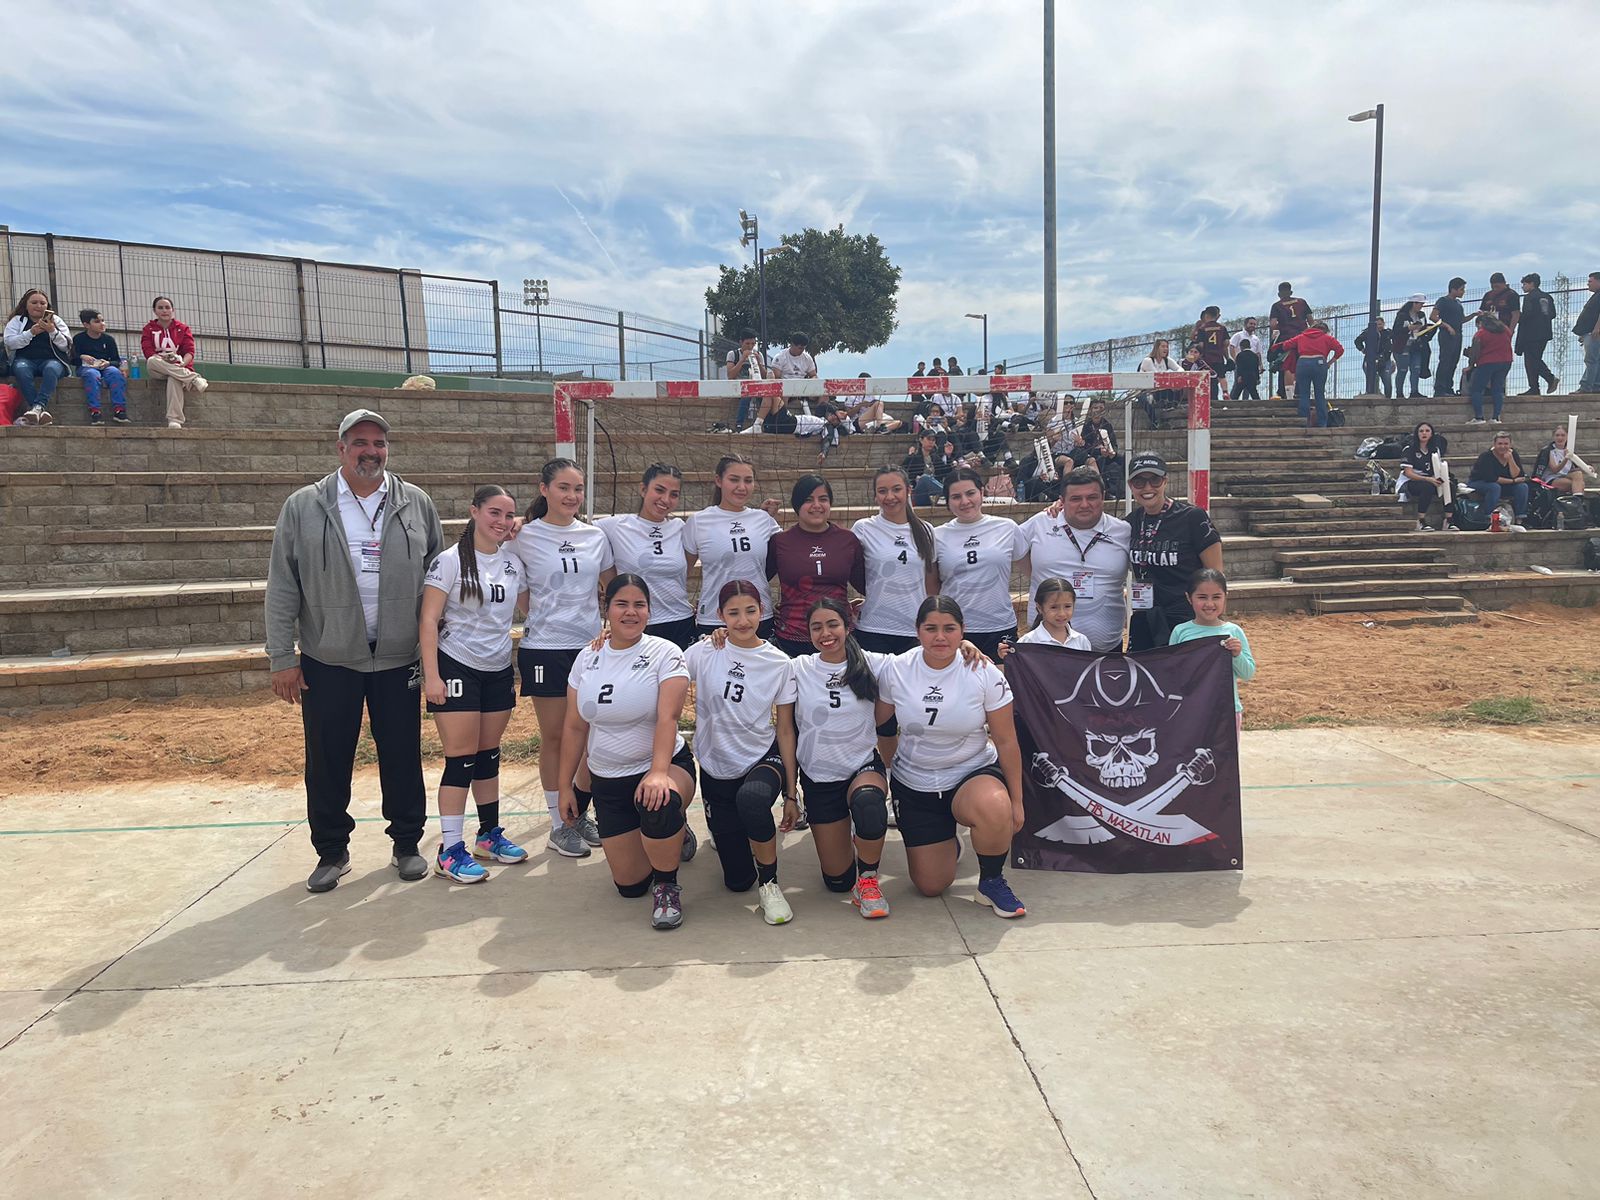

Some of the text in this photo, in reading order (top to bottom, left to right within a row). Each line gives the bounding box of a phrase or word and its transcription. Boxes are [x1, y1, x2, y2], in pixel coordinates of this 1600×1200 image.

[1208, 331, 1217, 345] 4
[1425, 462, 1431, 471] 3
[653, 541, 663, 555] 3
[731, 536, 751, 553] 16
[561, 557, 579, 574] 11
[897, 550, 908, 565] 4
[966, 550, 978, 565] 8
[815, 560, 822, 576] 1
[489, 583, 506, 603] 10
[534, 665, 544, 684] 11
[446, 679, 463, 698] 10
[597, 683, 614, 705] 2
[723, 681, 745, 703] 13
[829, 690, 842, 709] 5
[925, 707, 939, 726] 7
[1086, 800, 1171, 844] HB. MAZATLAN
